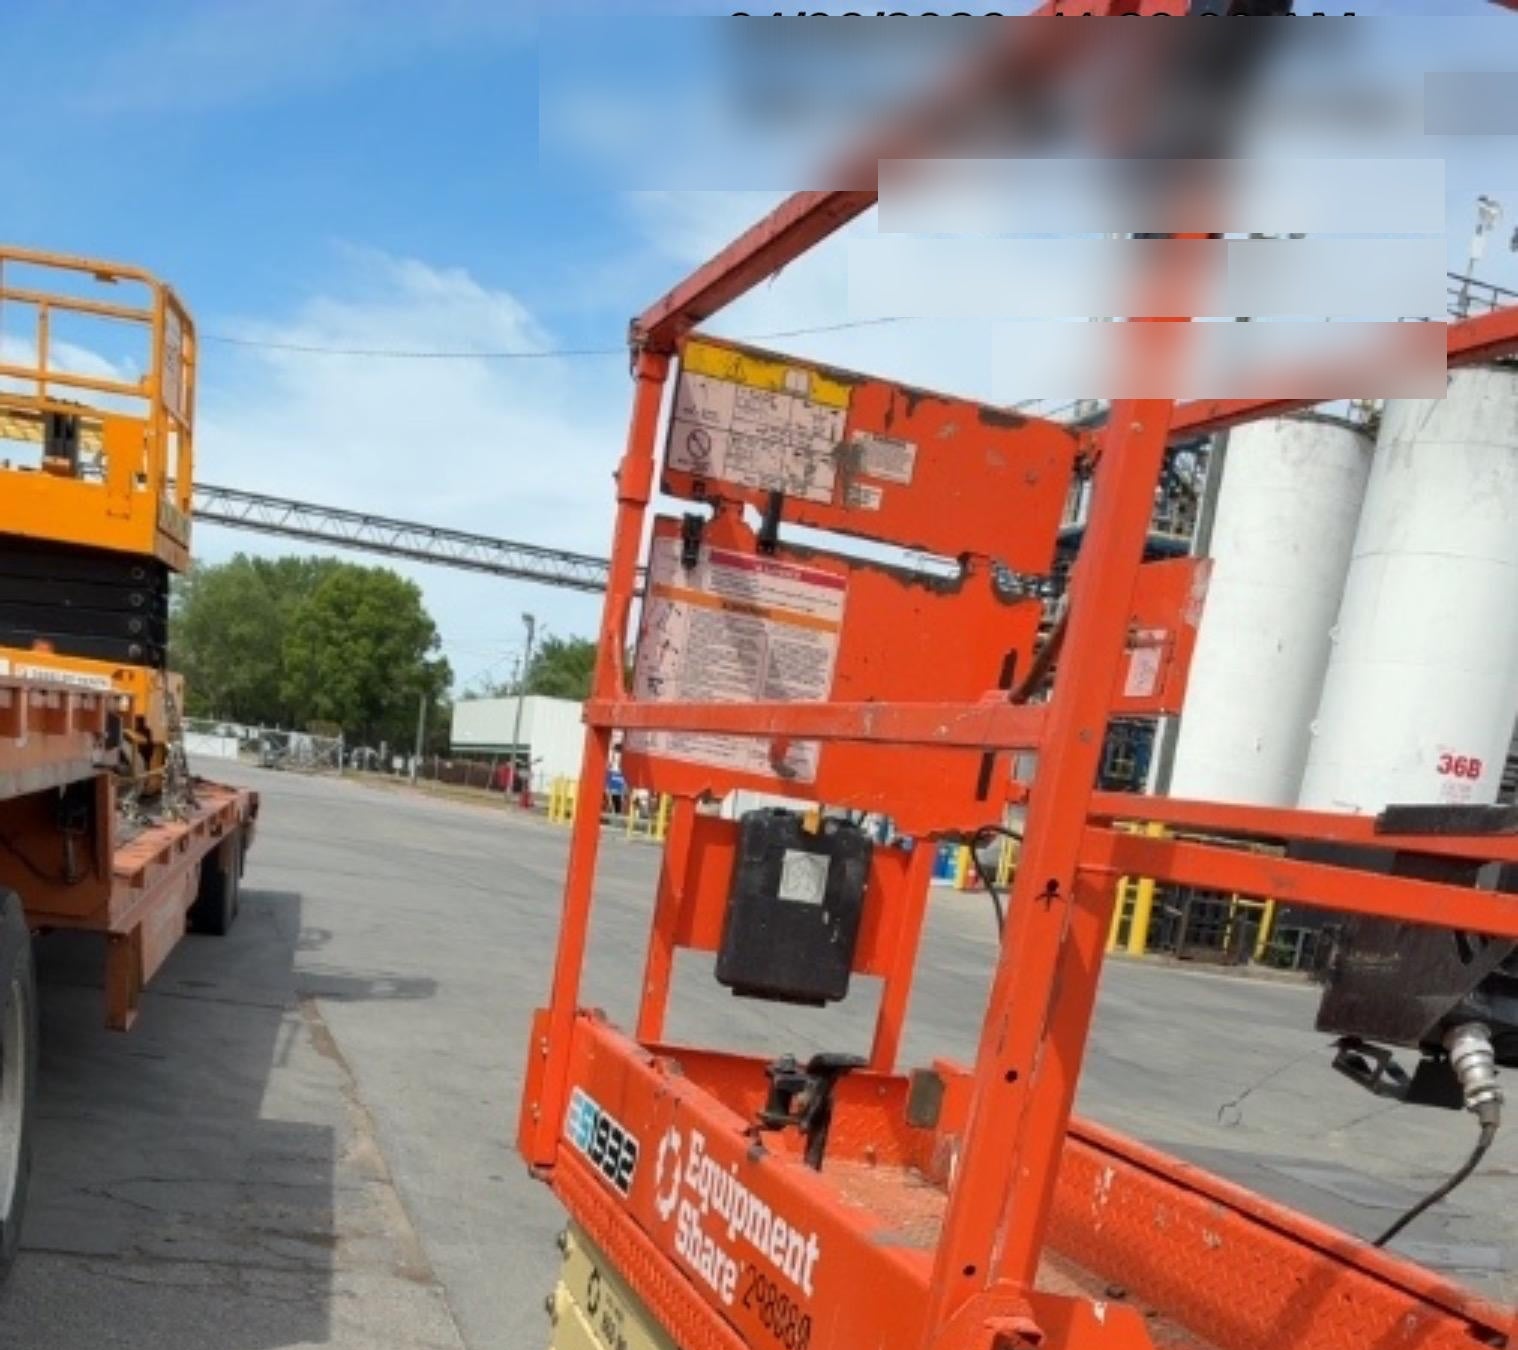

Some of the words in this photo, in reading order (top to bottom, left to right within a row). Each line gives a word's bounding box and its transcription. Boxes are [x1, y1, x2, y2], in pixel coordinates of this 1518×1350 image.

[1437, 753, 1482, 780] 36B
[675, 1199, 739, 1306] Share
[685, 1129, 820, 1297] Equipment
